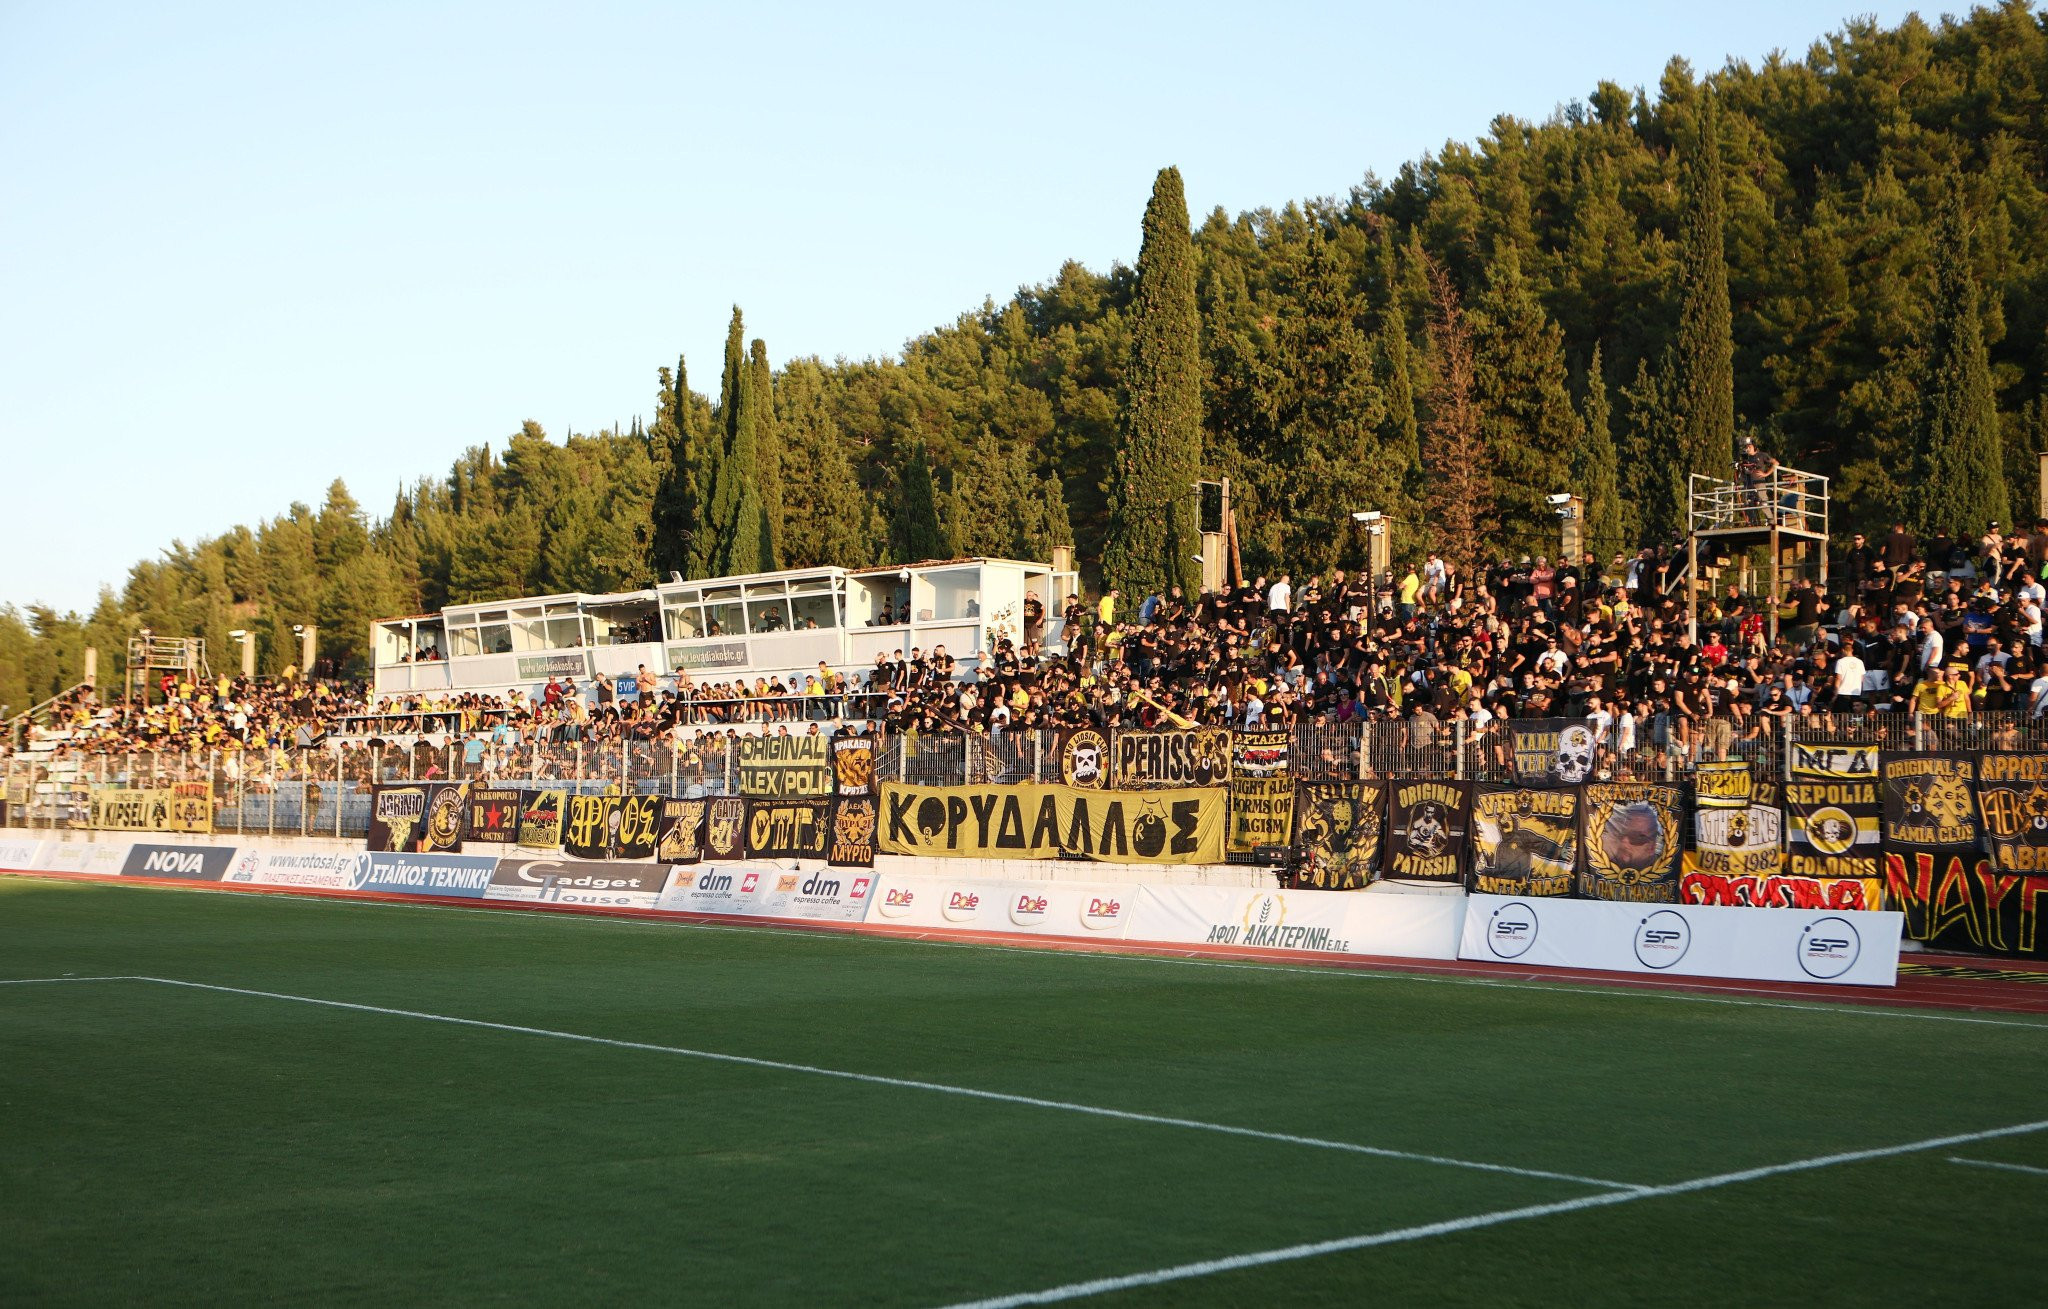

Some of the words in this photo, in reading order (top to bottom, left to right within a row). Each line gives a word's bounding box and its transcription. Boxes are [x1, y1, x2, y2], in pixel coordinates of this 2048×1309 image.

[741, 736, 825, 760] ORIGINAL
[1886, 758, 1955, 780] ORIGINAL
[1398, 783, 1463, 810] ORIGINAL
[1786, 783, 1876, 805] SEPOLIA
[1233, 799, 1270, 814] FORMS
[1274, 798, 1292, 814] OF
[473, 806, 484, 828] R
[502, 806, 516, 829] 21
[889, 792, 1200, 858] ΚΟΡΥΔΑΛΛΟΣ
[1239, 818, 1284, 834] RACISM
[1889, 823, 1936, 843] LAMIA
[144, 851, 204, 874] NOVA
[831, 844, 872, 862] ΛΑΥΡΙΟ
[270, 853, 350, 874] www.rotosal.gr
[1392, 852, 1456, 876] PATISSIA
[430, 866, 493, 890] ΤΕΧΝΙΚΗ
[518, 860, 642, 890] Gadget
[699, 868, 733, 891] dim
[743, 876, 758, 891] illy
[802, 872, 841, 896] dim
[690, 892, 715, 900] espresso
[714, 891, 732, 899] coffee
[852, 881, 868, 896] illy
[886, 888, 914, 904] Dole
[1530, 876, 1571, 896] NAZI
[794, 896, 820, 905] espresso
[821, 896, 841, 905] coffee
[950, 892, 979, 908] Dole
[1017, 895, 1048, 912] Dole
[1088, 898, 1120, 915] Dole
[1206, 924, 1240, 944] ΑΦΟΙ
[1242, 924, 1330, 951] ΑΙΚΑΤΕΡΙΝΗ
[1496, 922, 1529, 934] SP
[1644, 930, 1681, 944] SP
[1808, 938, 1850, 952] SP
